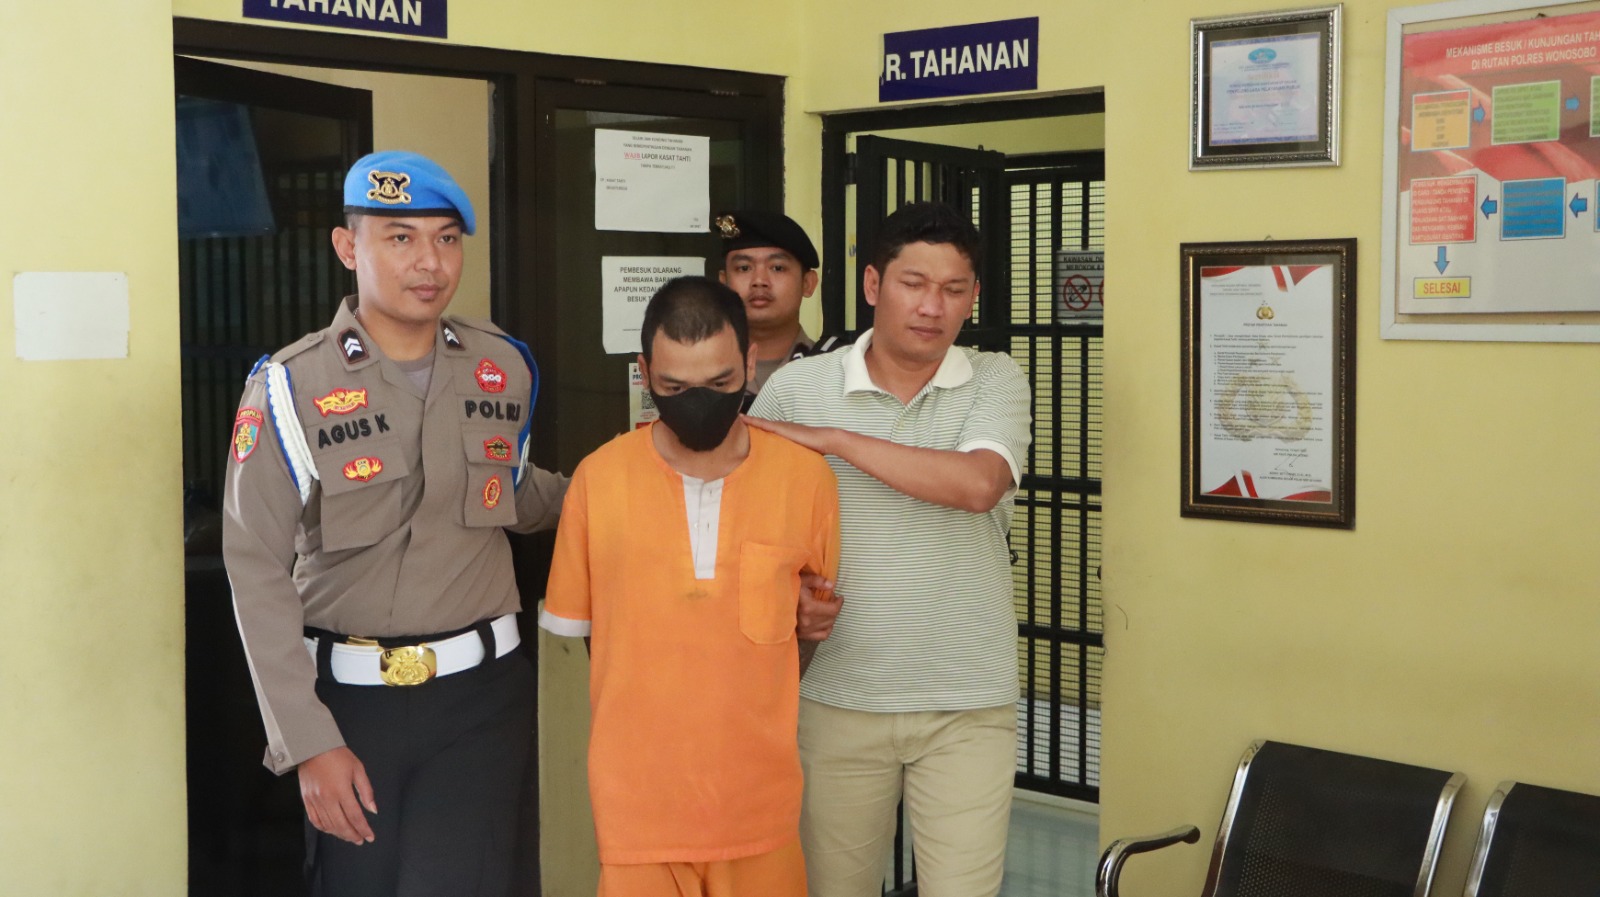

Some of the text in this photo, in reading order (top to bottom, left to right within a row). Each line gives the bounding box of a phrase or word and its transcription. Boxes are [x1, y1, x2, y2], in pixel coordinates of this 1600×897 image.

[1446, 42, 1494, 58] MEKANISME
[1495, 39, 1522, 53] BESUK
[1528, 32, 1582, 49] KUNJUNGAN
[1584, 30, 1600, 42] TAH
[910, 38, 1029, 79] TAHANAN
[1471, 46, 1597, 70] DI RUTAN POLRES WONOSOBO
[620, 266, 682, 274] PEMBESUK DILARANG
[627, 295, 647, 303] BESUK
[1423, 282, 1461, 294] SELESAI
[465, 400, 521, 422] POLRI
[318, 413, 390, 449] AGUS K
